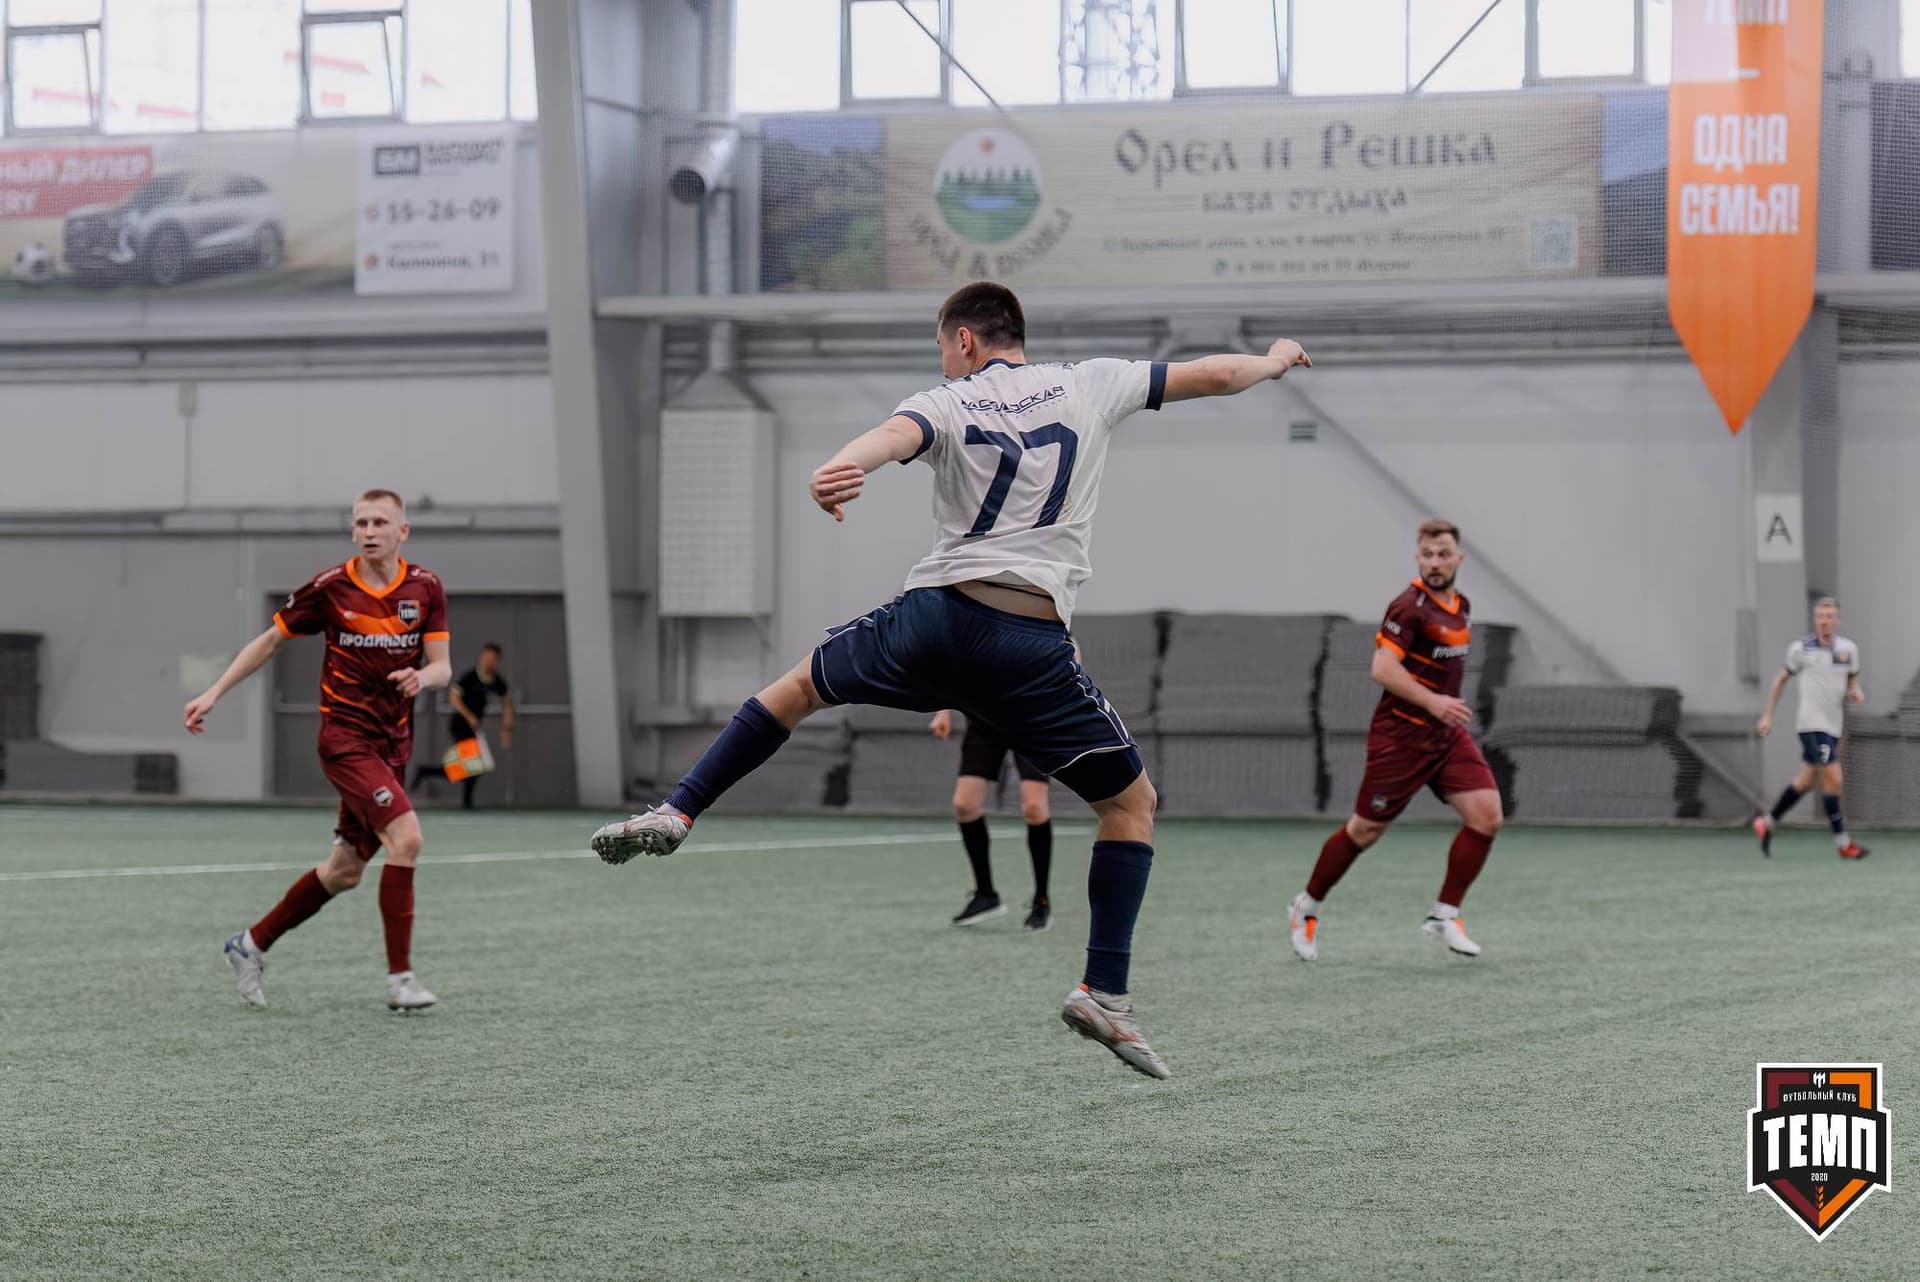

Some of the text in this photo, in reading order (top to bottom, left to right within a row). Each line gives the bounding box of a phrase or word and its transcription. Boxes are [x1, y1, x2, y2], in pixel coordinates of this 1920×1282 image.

[1693, 113, 1788, 173] ОДНА
[1680, 184, 1800, 235] СЕМЬЯ!
[963, 422, 1079, 539] 77
